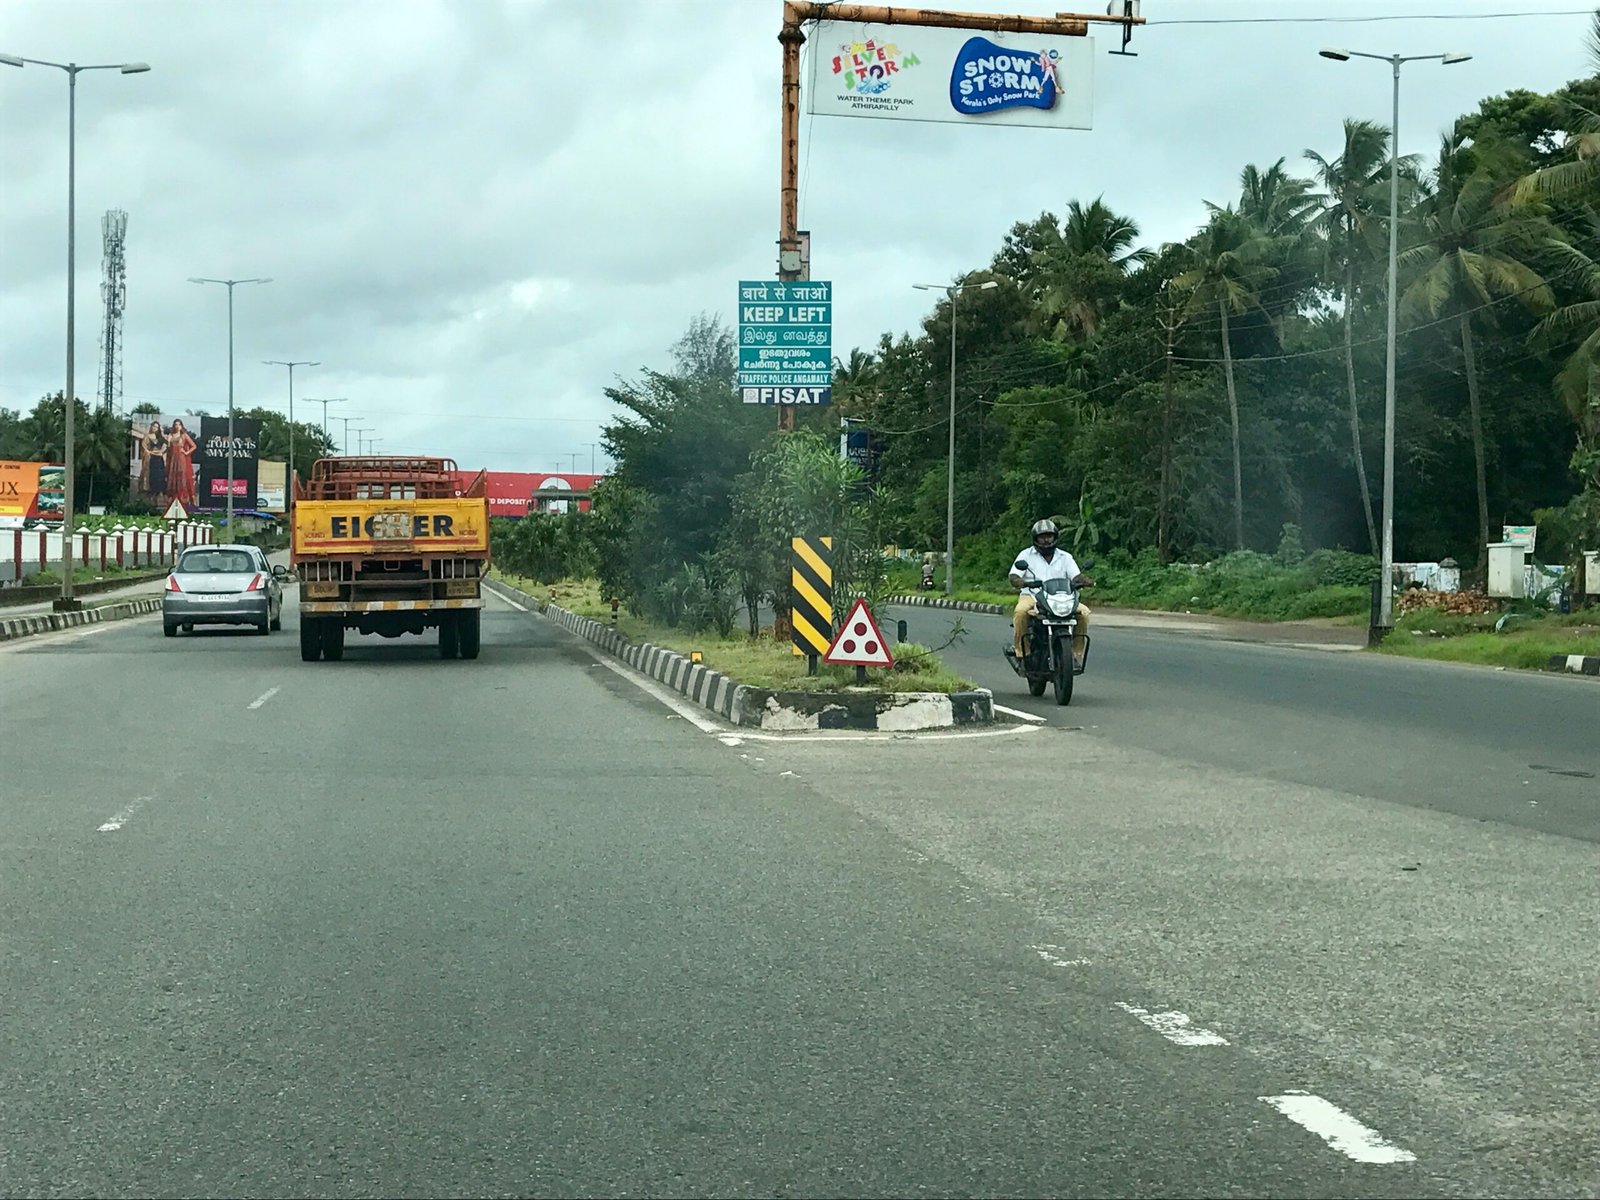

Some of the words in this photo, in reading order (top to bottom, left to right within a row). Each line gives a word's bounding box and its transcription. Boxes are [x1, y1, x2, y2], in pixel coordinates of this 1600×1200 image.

[832, 43, 902, 75] SILVER
[964, 55, 1032, 77] SNOW
[844, 51, 921, 90] STORM
[959, 71, 1041, 95] STORM
[837, 95, 864, 103] WATER
[866, 96, 892, 104] THEME
[851, 102, 899, 111] ATHIRAPILLY
[961, 96, 988, 107] Kerala's
[987, 95, 1003, 104] Only
[1003, 92, 1023, 101] Snow
[1023, 90, 1041, 100] Park
[774, 282, 787, 301] से
[792, 282, 829, 301] जाओ
[743, 306, 784, 322] KEEP
[788, 306, 827, 322] LEFT
[782, 361, 827, 371] പോകുക
[740, 374, 768, 384] TRAFFIC
[768, 374, 792, 384] POLICE
[793, 374, 829, 384] ANGAMALY
[760, 387, 824, 404] FISAT
[209, 449, 225, 457] MY
[331, 515, 454, 538] EICER
